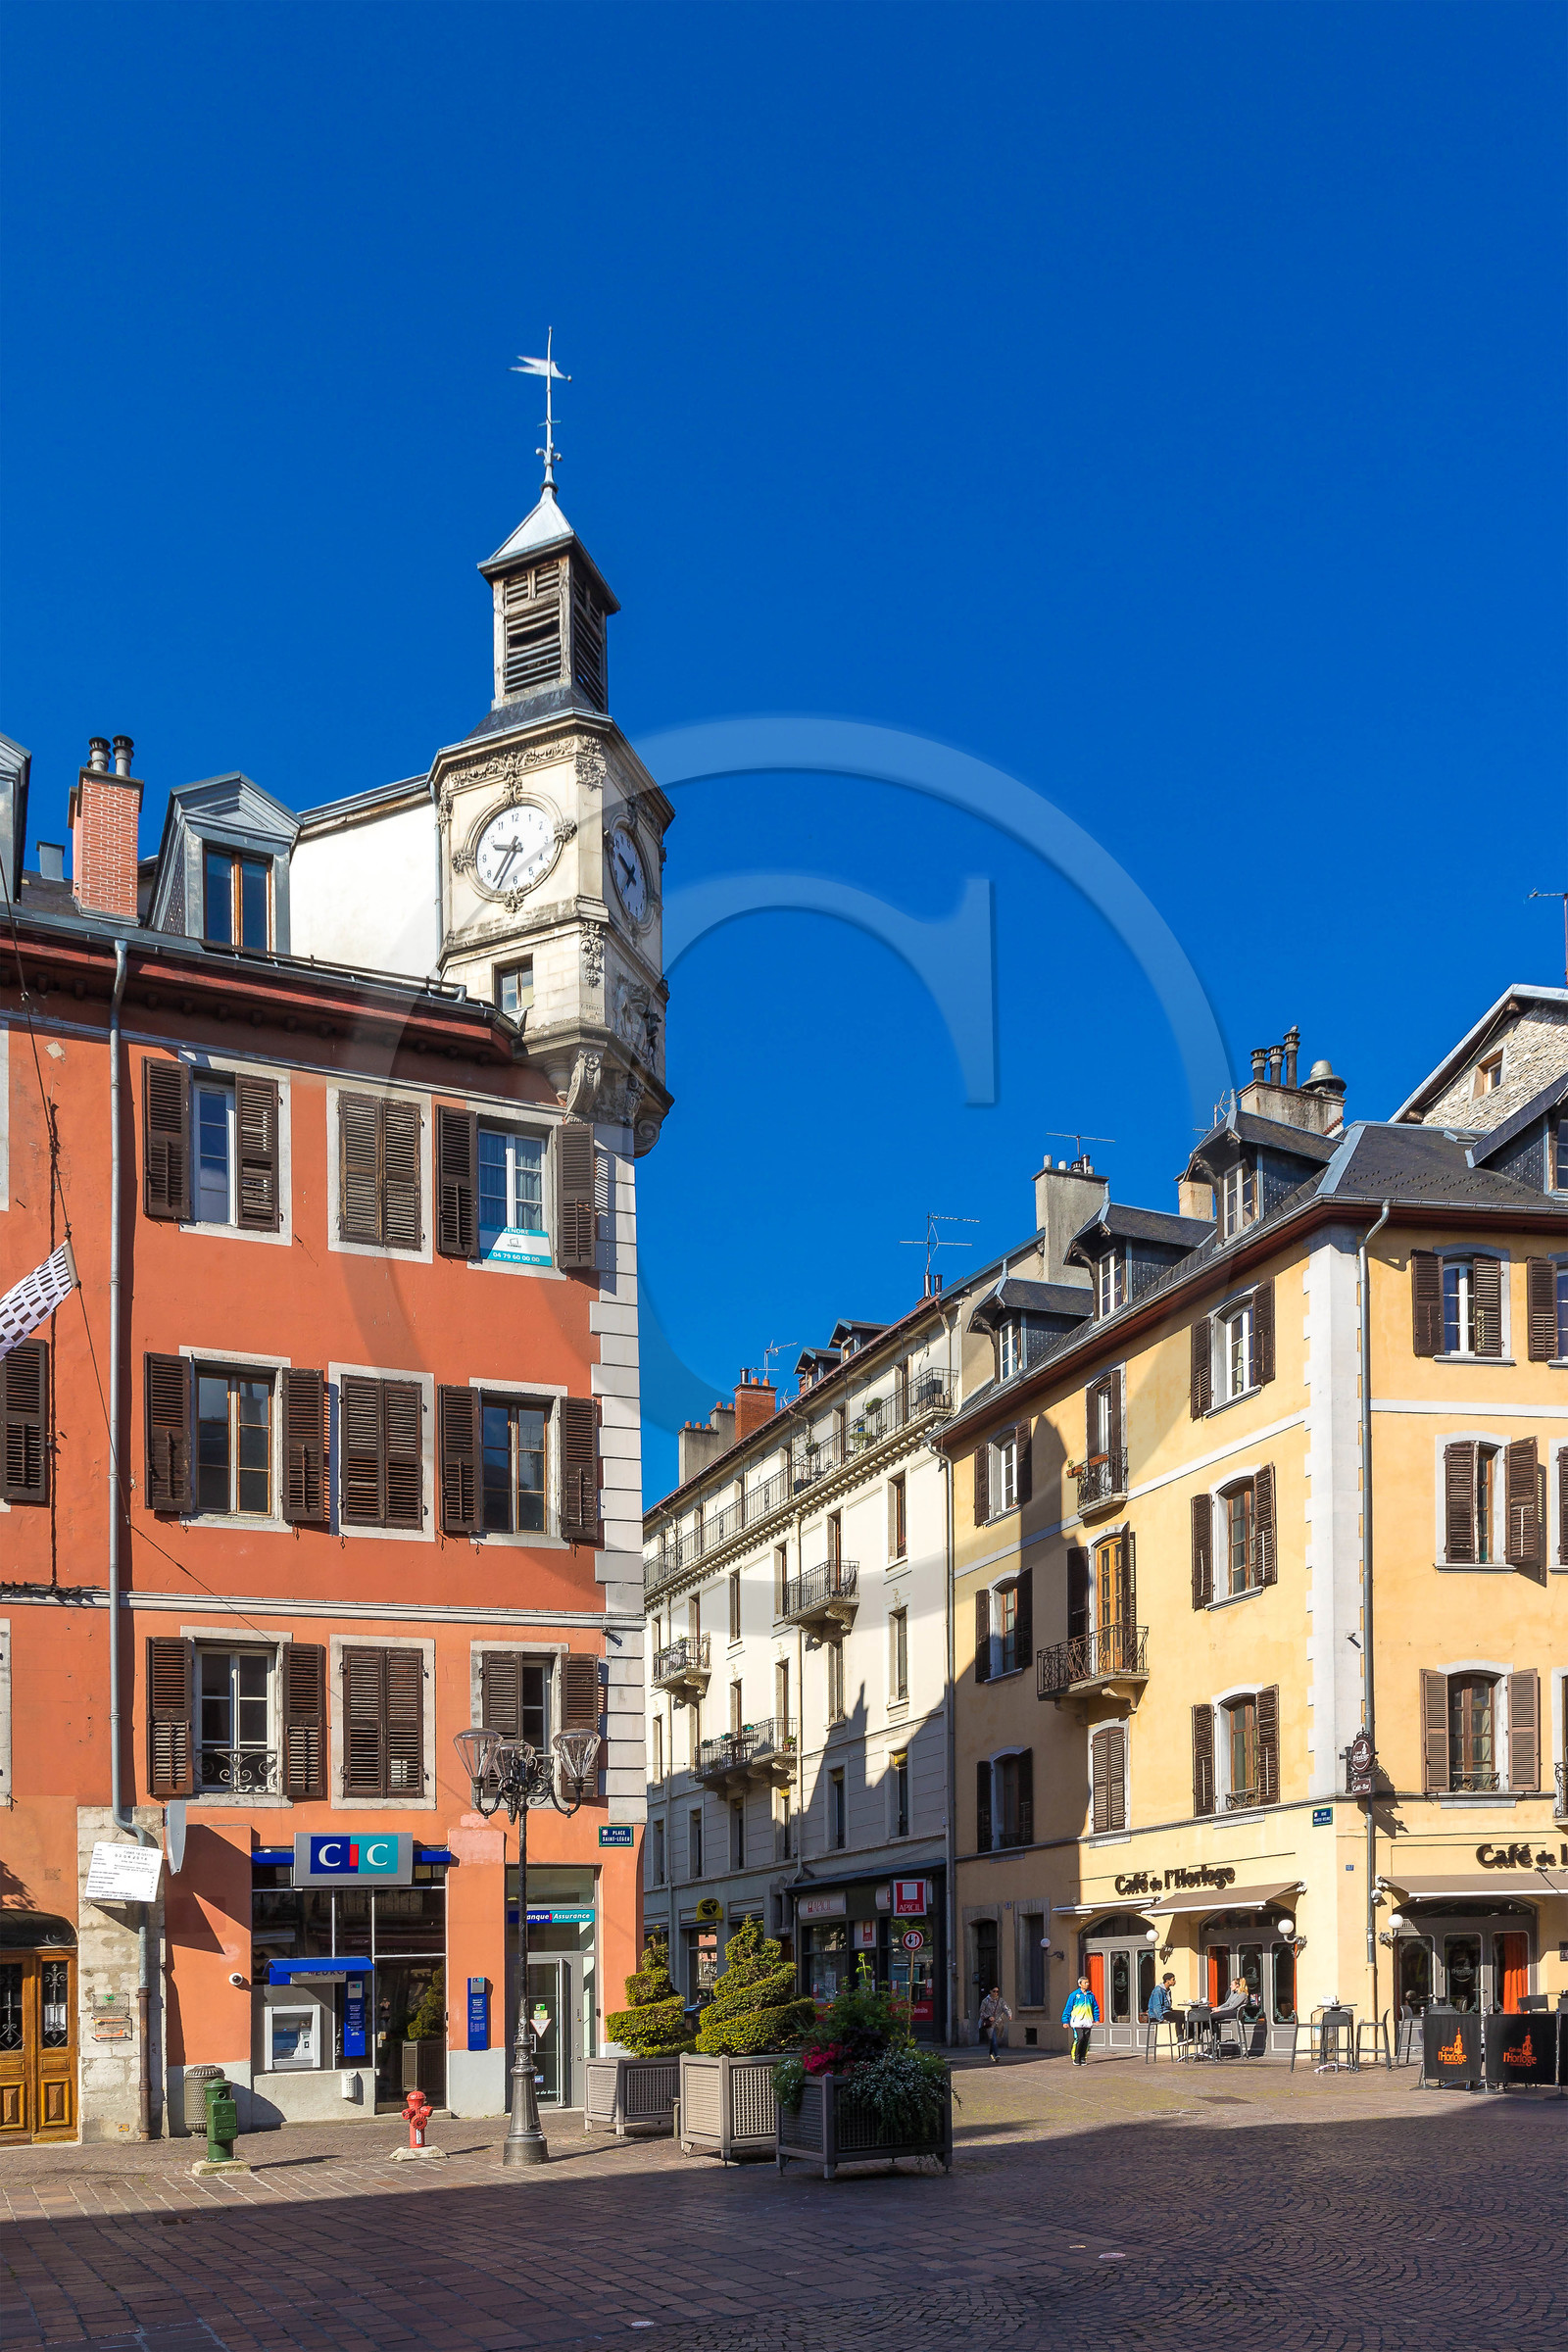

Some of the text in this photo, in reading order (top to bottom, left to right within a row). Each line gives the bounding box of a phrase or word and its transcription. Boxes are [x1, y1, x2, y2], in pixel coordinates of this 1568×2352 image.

[318, 1843, 389, 1867] CIC
[1476, 1843, 1533, 1869] Café
[1536, 1850, 1557, 1866] de
[1115, 1864, 1235, 1896] Café de l'Horloge
[527, 1913, 549, 1921] anque
[1438, 2051, 1467, 2064] l'Horloge
